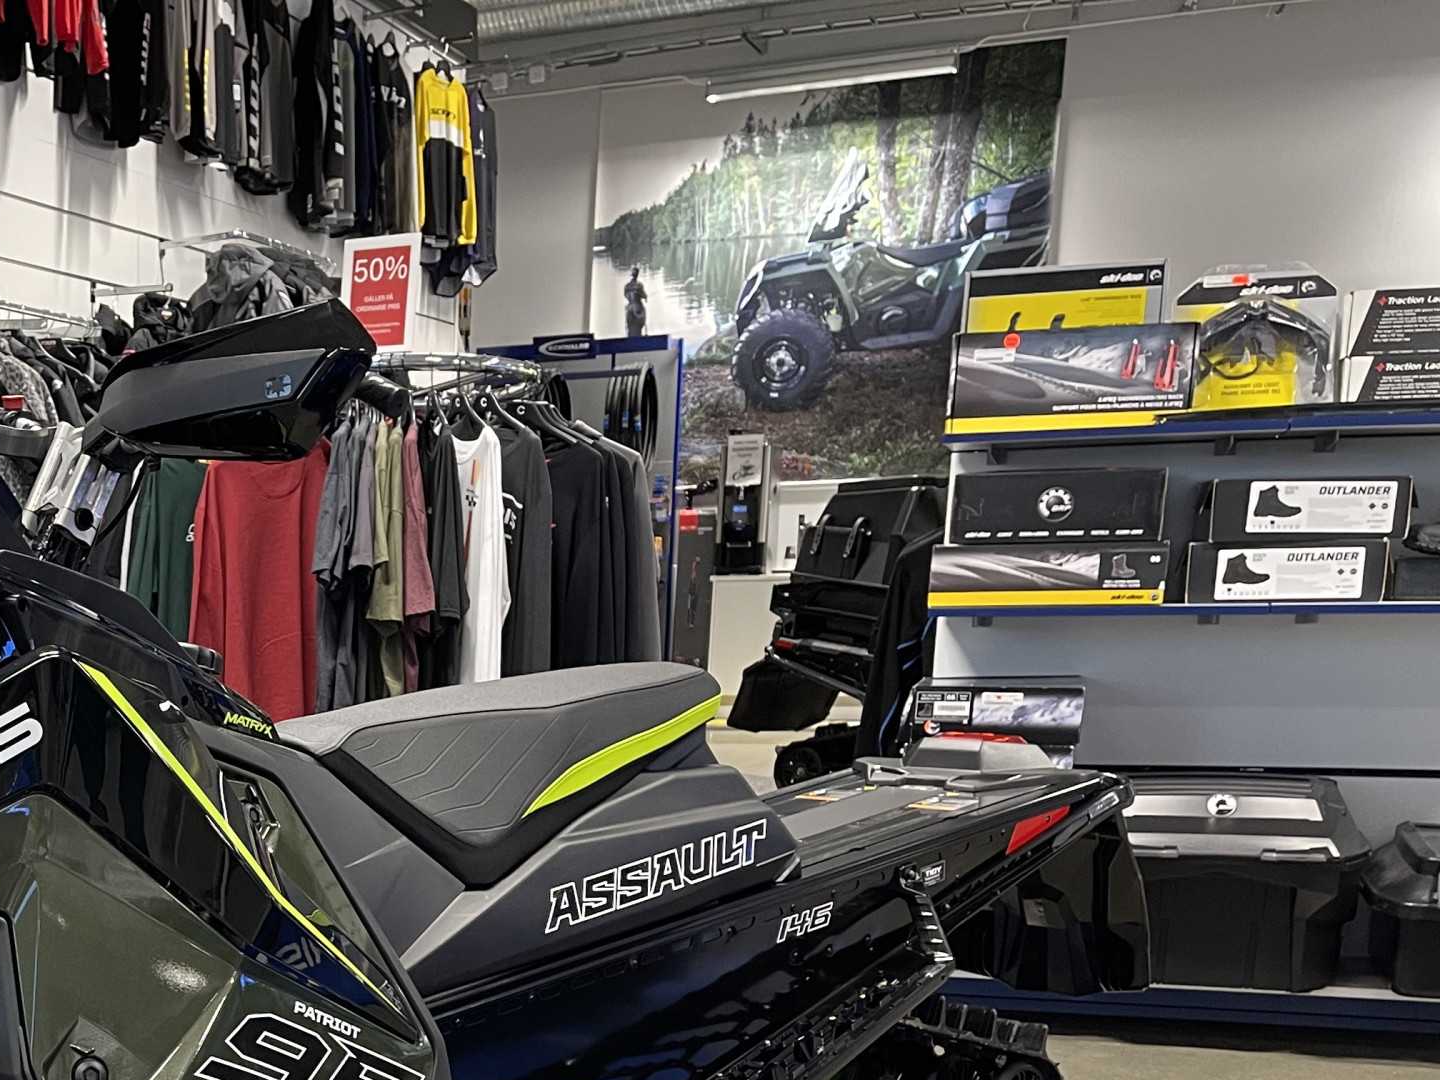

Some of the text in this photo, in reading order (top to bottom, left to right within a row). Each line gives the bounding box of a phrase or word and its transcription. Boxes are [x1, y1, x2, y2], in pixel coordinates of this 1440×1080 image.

[354, 255, 408, 283] 50%
[1387, 296, 1425, 305] Traction
[1385, 363, 1422, 371] Traction
[1319, 486, 1391, 496] OUTLANDER
[1287, 552, 1359, 562] OUTLANDER
[224, 711, 273, 740] MATRYX
[544, 819, 768, 935] ASSAULT
[776, 901, 834, 943] 146
[293, 1000, 362, 1039] PATRIOT
